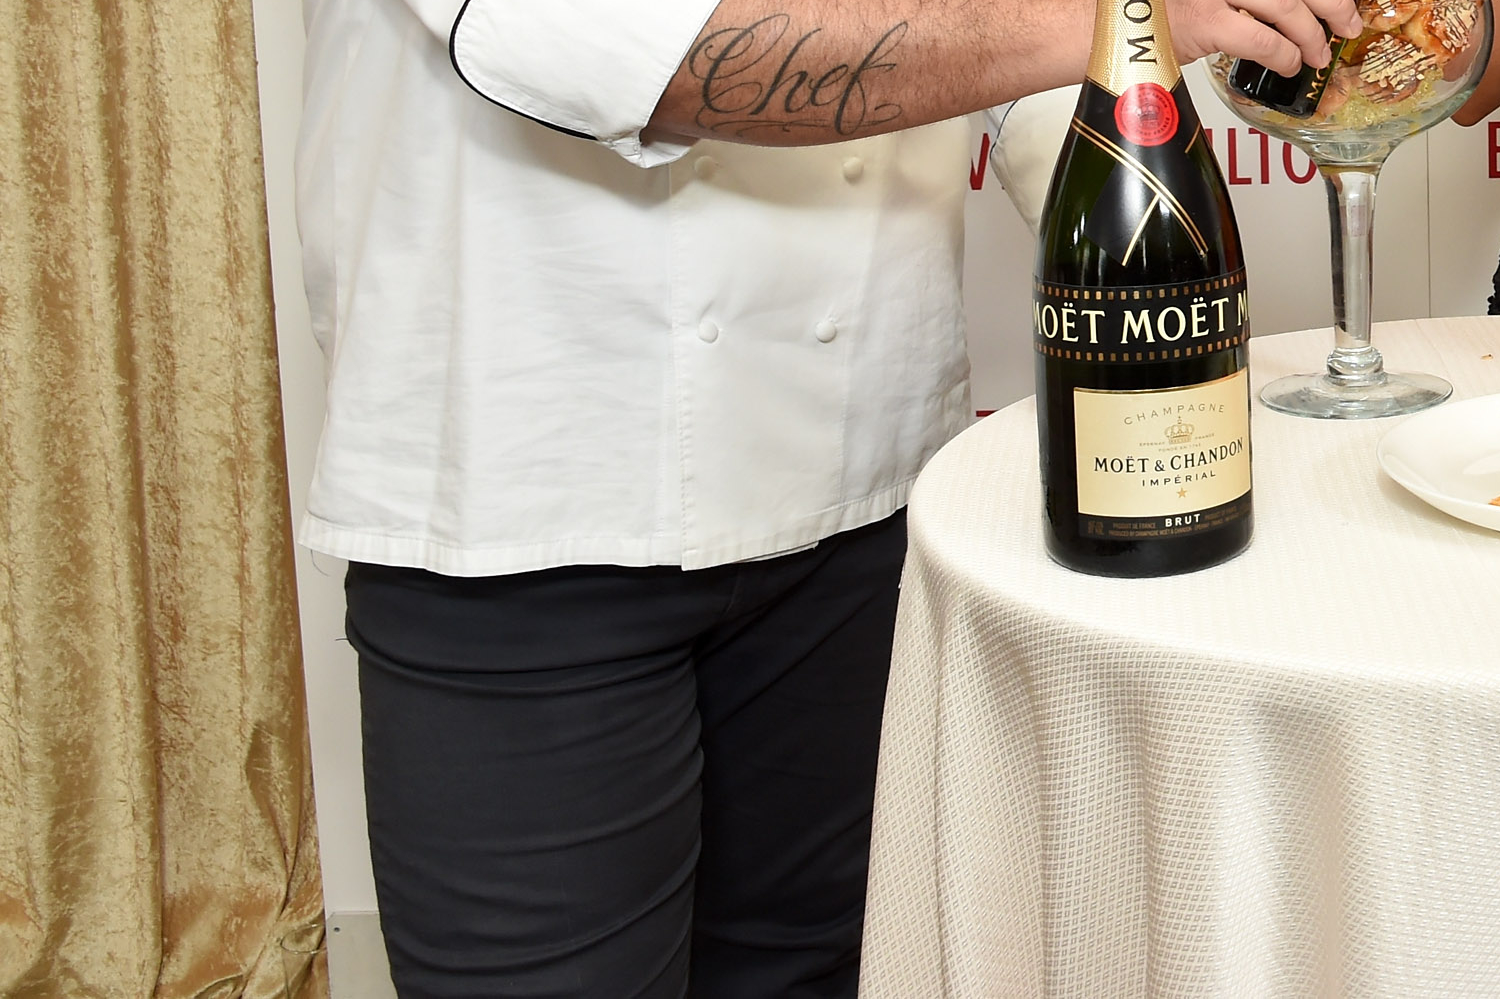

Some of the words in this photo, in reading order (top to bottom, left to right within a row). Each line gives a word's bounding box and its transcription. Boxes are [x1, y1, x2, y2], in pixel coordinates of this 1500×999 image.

[688, 13, 908, 136] Chef
[1119, 296, 1230, 345] MOËT
[1123, 402, 1225, 426] CHAMPAGNE
[1093, 455, 1150, 474] MOËT
[1154, 459, 1165, 473] &
[1170, 436, 1244, 471] CHANDON
[1141, 469, 1217, 488] IMPÉRIAL
[1164, 513, 1201, 529] BRUT
